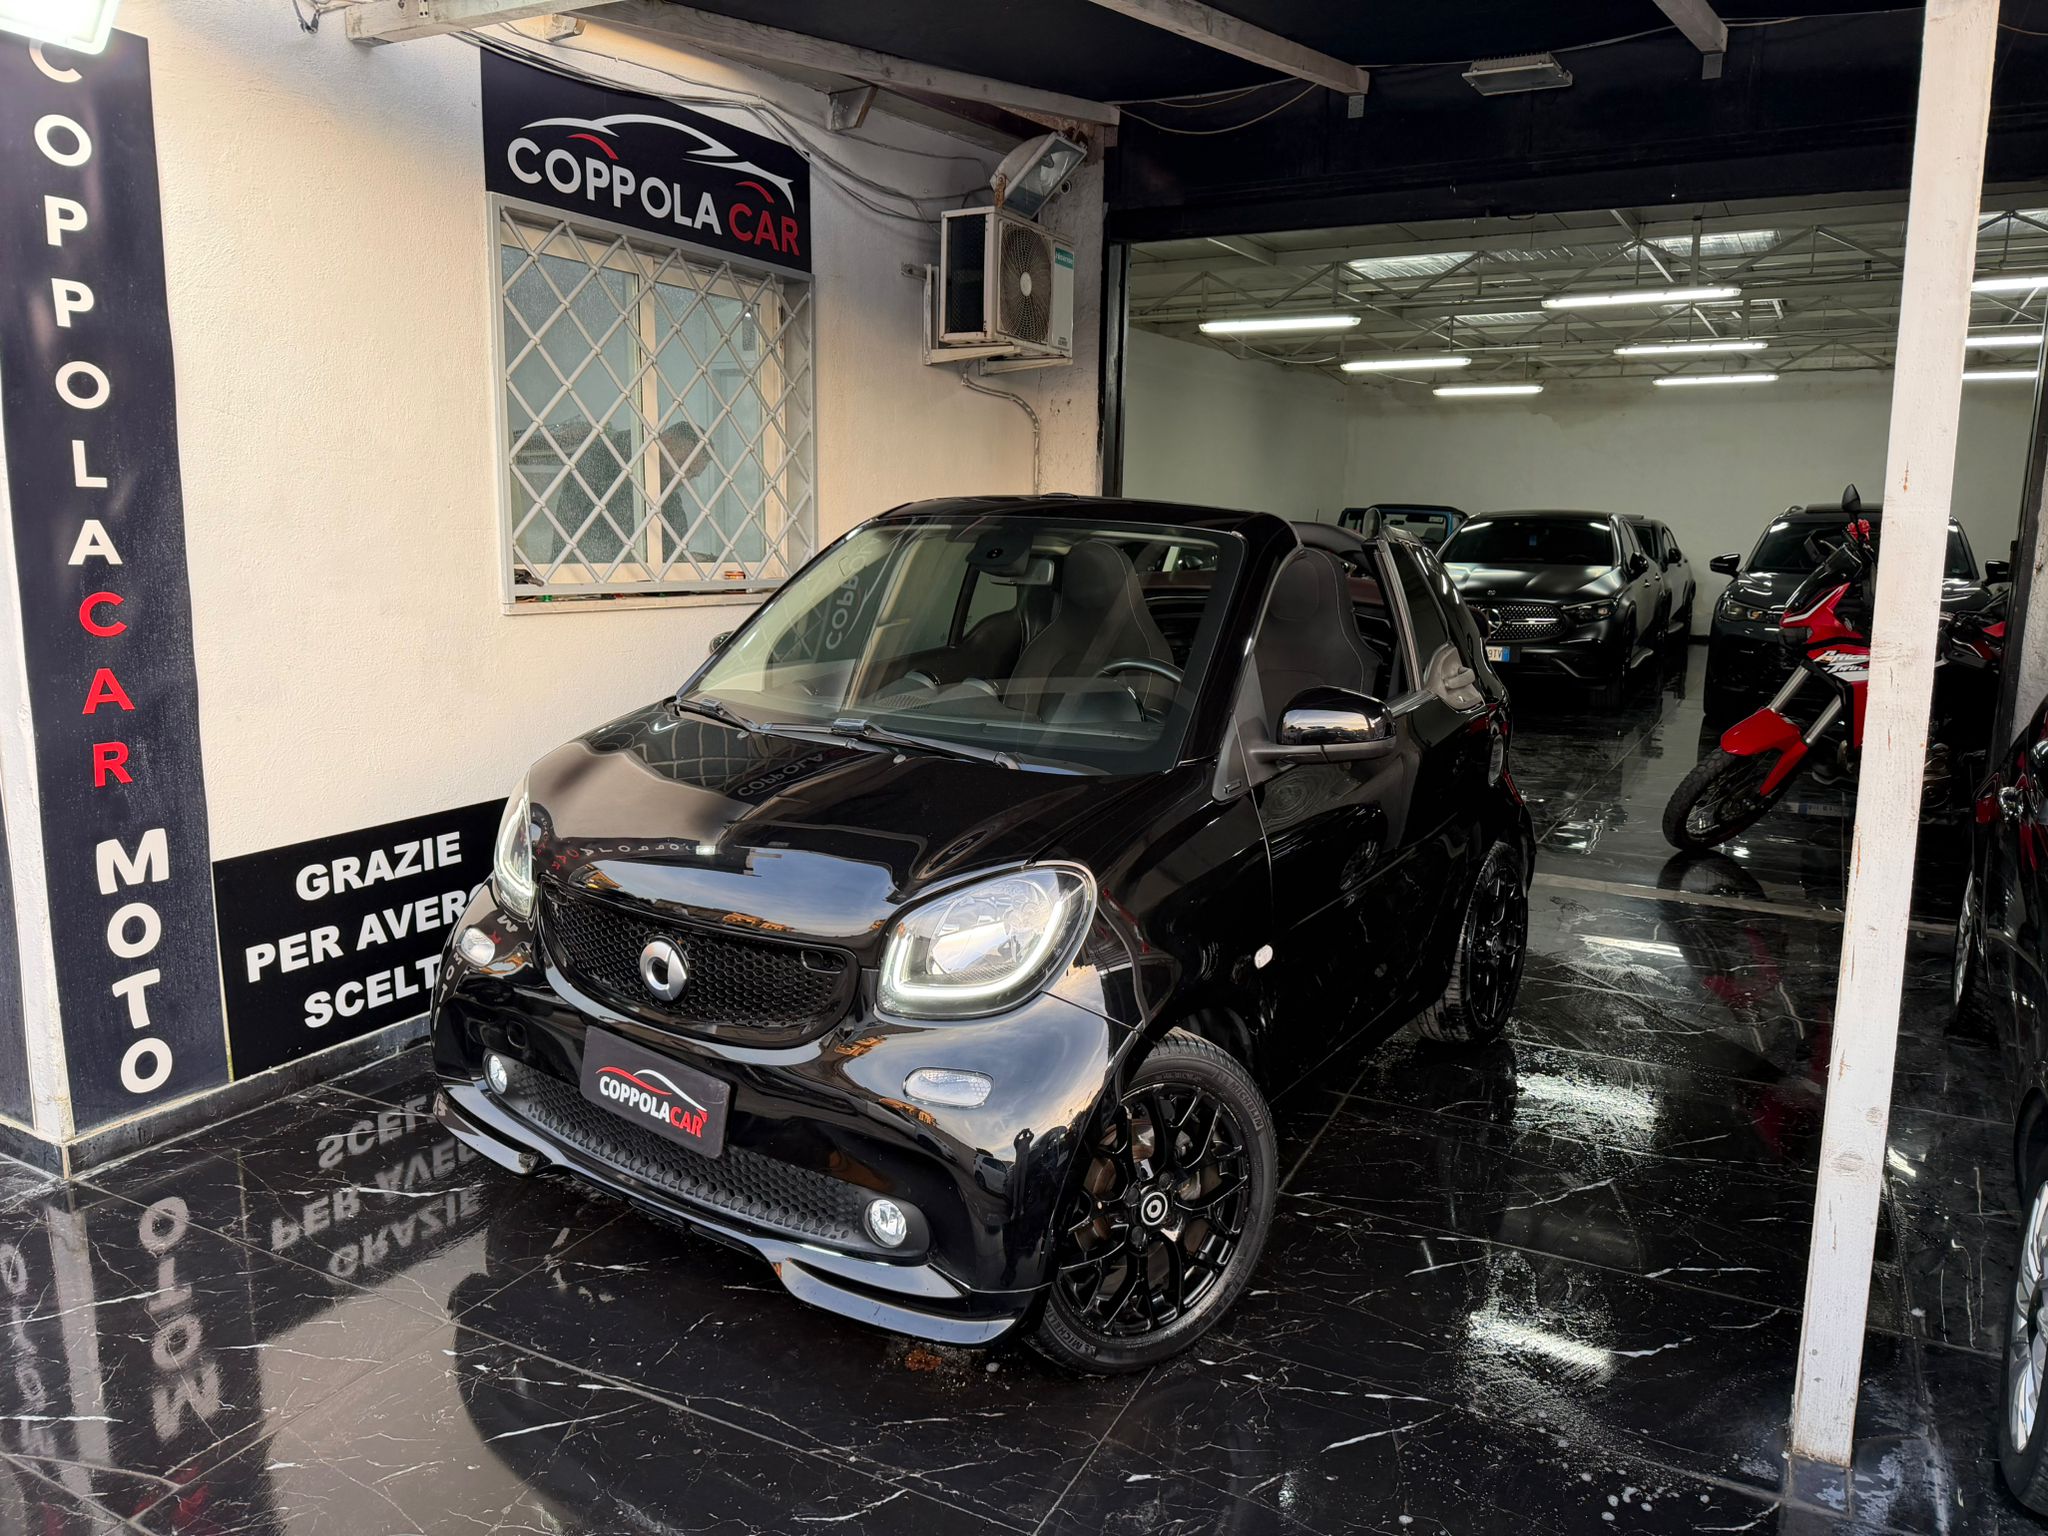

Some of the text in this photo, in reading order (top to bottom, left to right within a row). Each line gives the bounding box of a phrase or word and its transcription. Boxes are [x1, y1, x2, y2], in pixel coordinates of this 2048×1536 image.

[295, 831, 462, 901] GRAZIE
[95, 828, 173, 1093] MOTO
[245, 883, 483, 983] PER AVER
